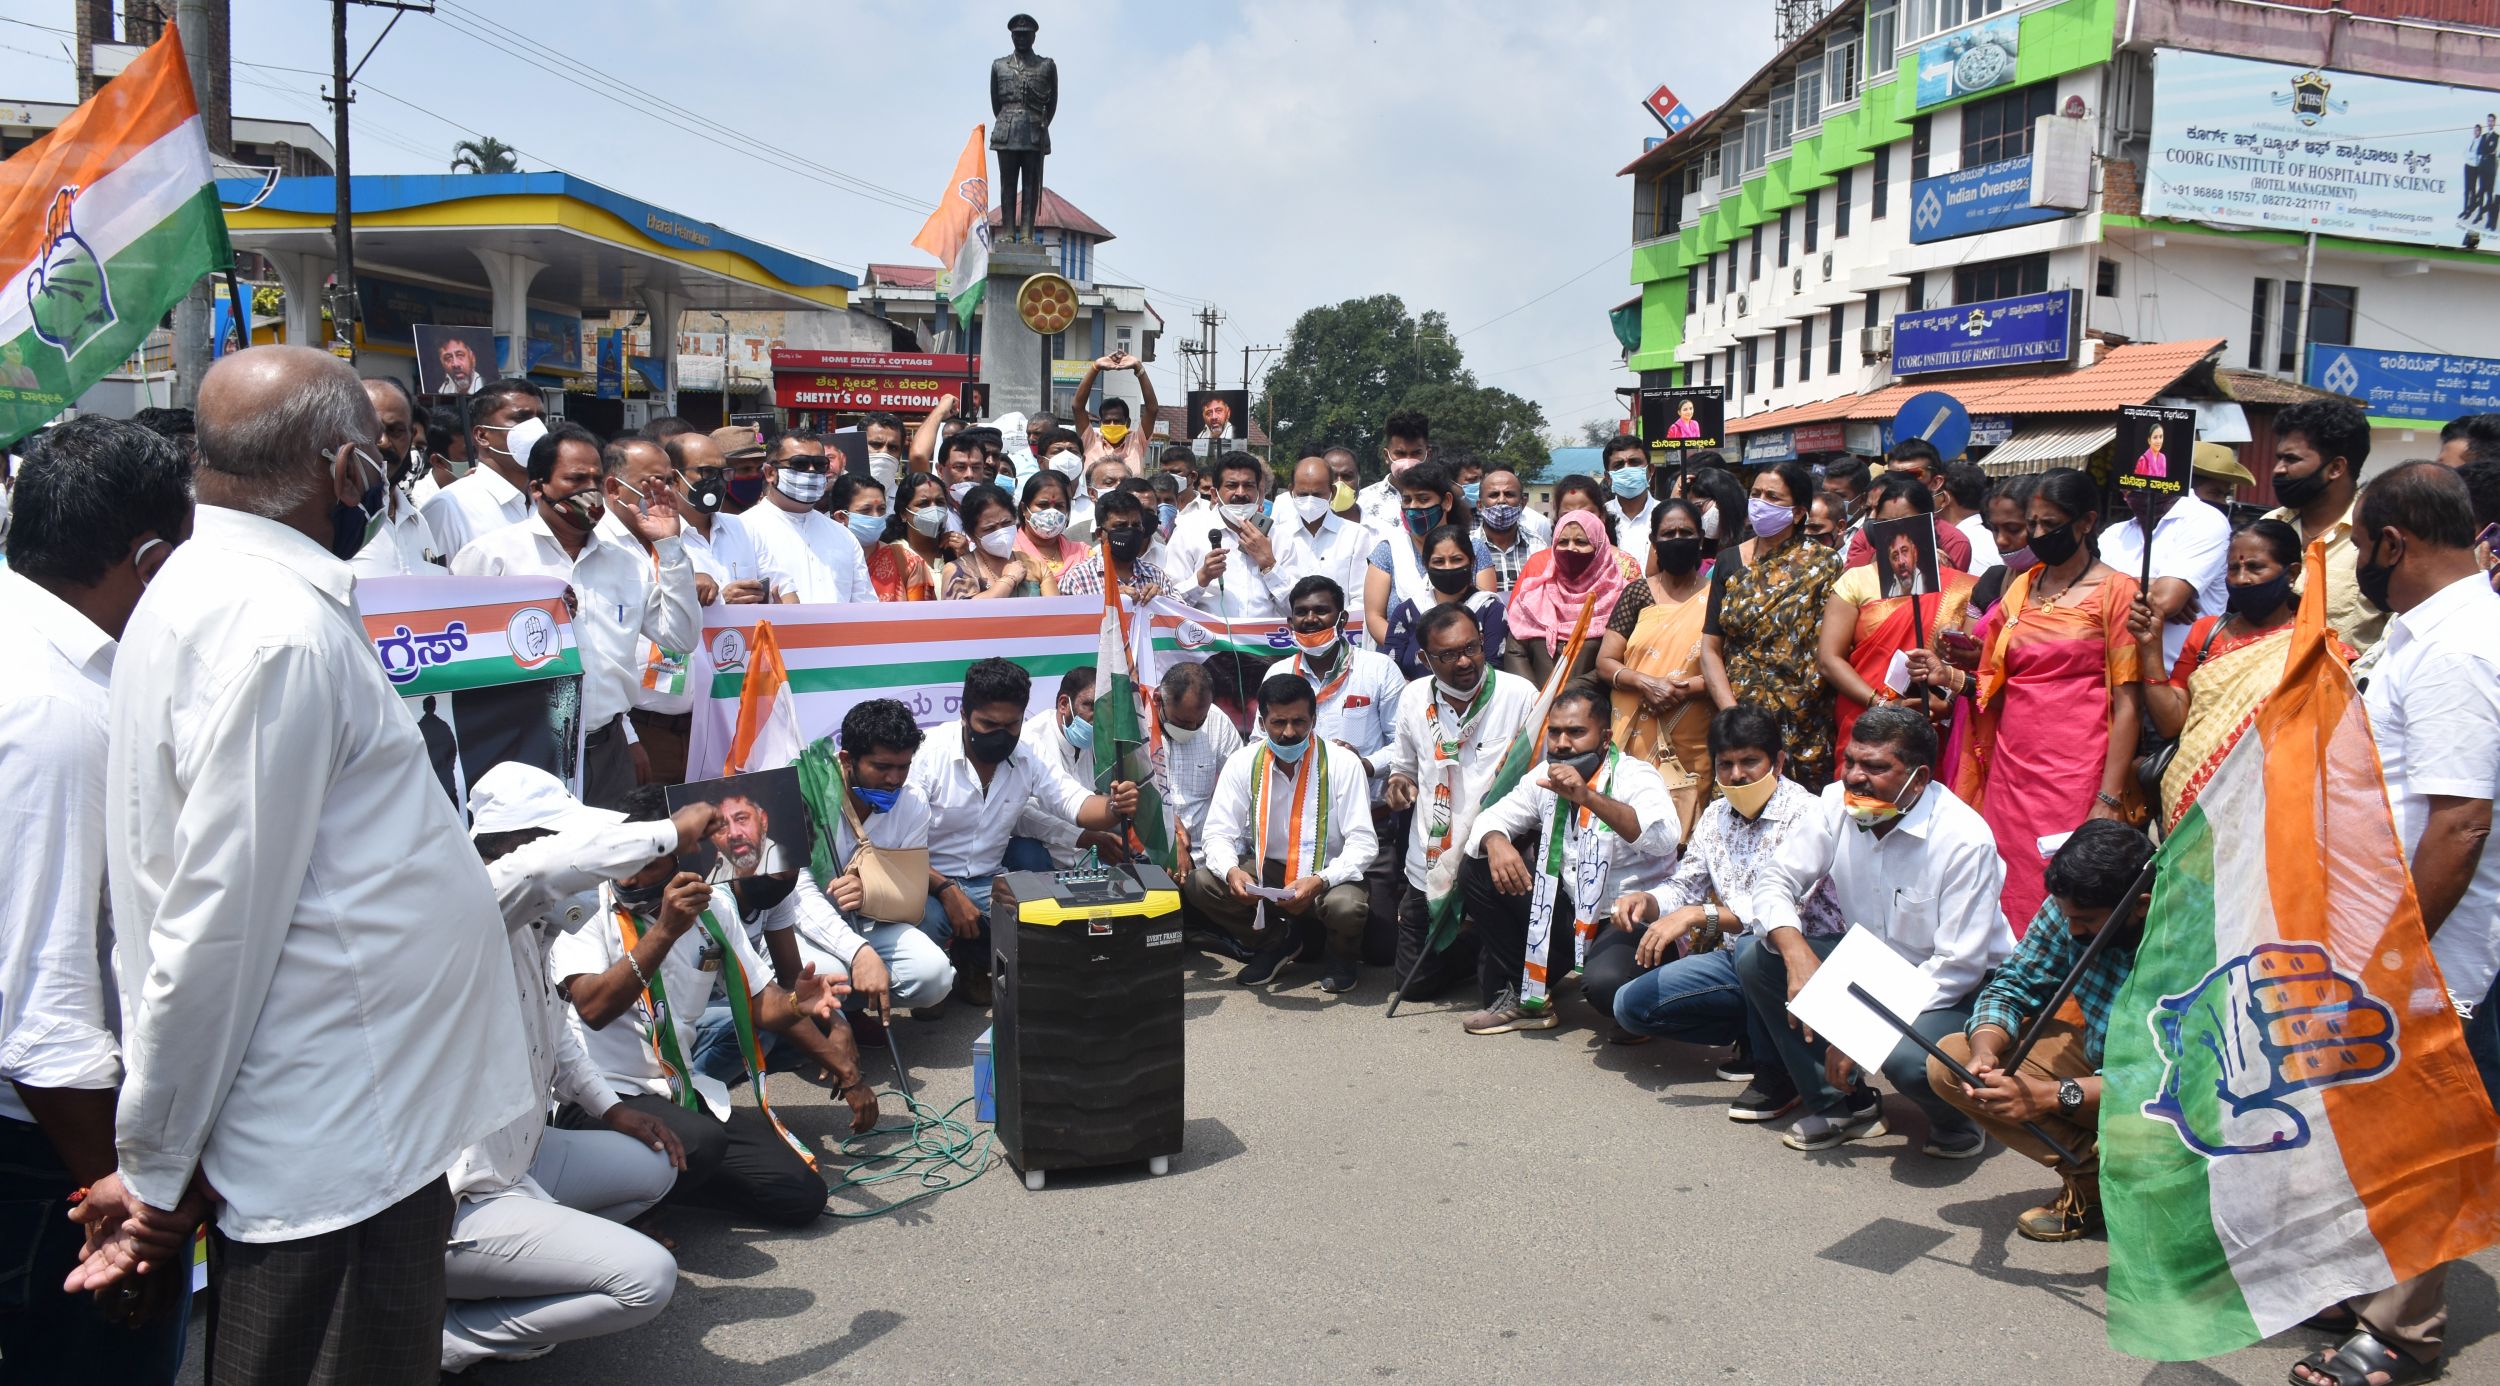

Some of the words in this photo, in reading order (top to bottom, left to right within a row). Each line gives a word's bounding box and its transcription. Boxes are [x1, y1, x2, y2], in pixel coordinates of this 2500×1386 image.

[2066, 101, 2084, 115] Jio
[2299, 92, 2321, 107] CIHS
[2166, 147, 2213, 167] COORG
[2217, 153, 2285, 175] INSTITUTE
[2289, 162, 2306, 178] OF
[2308, 164, 2391, 188] HOSPITALITY
[2393, 175, 2446, 194] SCIENCE
[1946, 187, 1977, 206] Indian
[1980, 177, 2030, 199] Overseas
[2251, 176, 2285, 192] (HOTEL
[2288, 181, 2357, 201] MANAGEMENT)
[2172, 184, 2190, 196] +91
[2193, 186, 2224, 200] 96868
[2262, 194, 2331, 212] 08272-221717
[850, 356, 877, 364] STAYS
[888, 357, 933, 366] COTTAGES
[1898, 354, 1923, 369] COORG
[1924, 350, 1961, 366] INSTITUTE
[1961, 350, 1972, 364] OF
[1973, 343, 2024, 362] HOSPITALITY
[2024, 338, 2061, 356] SCIENCE
[2379, 355, 2441, 372] ಇಂಡಿಯನ್
[883, 378, 895, 389] &
[899, 378, 939, 390] ಬೇಕರಿ
[795, 390, 851, 404] SHETTY'S
[880, 394, 939, 407] FECTIONA
[2460, 394, 2487, 407] Indian
[1651, 439, 1681, 449] ಮನಿಷಾ
[1684, 437, 1716, 450] ವಾಲ್ಮೀಕಿ
[2119, 474, 2147, 489] ಮನಿಷಾ
[2150, 480, 2181, 494] ವಾಲ್ಮೀಕಿ
[377, 621, 469, 684] ಗ್ರೆಸ್
[1146, 934, 1162, 943] EVENT
